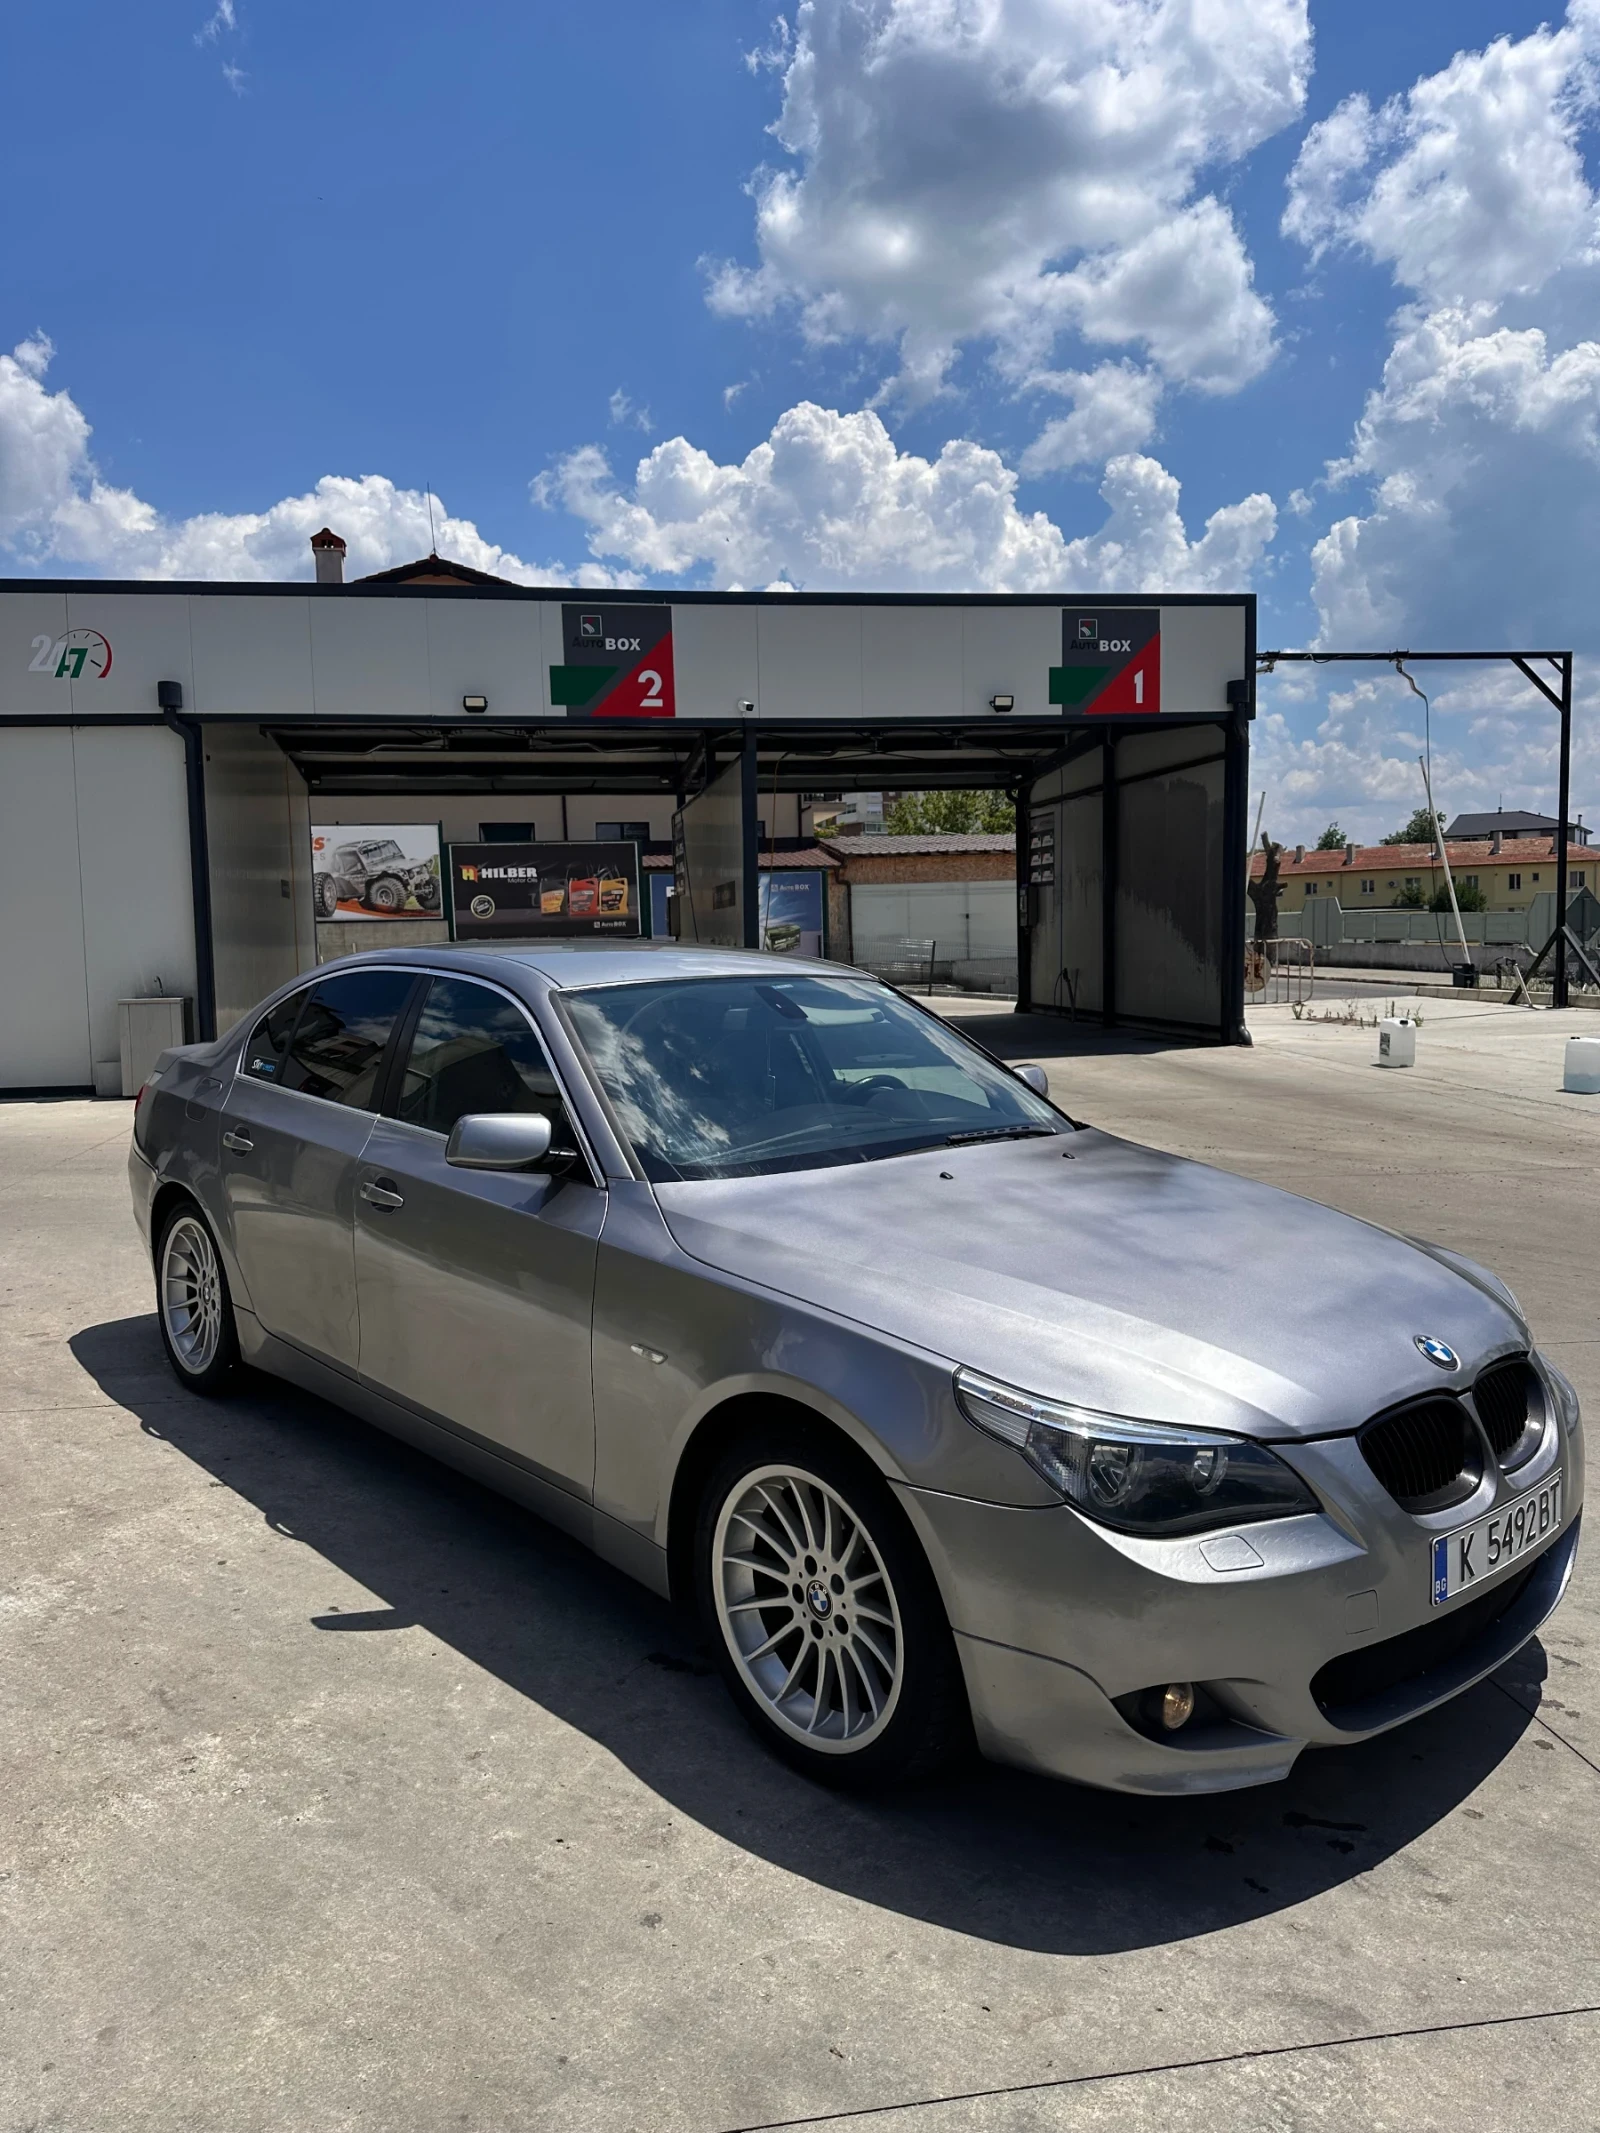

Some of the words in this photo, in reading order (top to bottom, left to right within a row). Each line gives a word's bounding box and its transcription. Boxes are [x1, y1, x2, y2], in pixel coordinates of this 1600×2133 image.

[604, 637, 641, 651] BOX
[1099, 639, 1131, 652] BOX
[637, 669, 664, 707] 2
[1134, 668, 1144, 704] 1
[481, 867, 538, 879] HILBER
[1460, 1531, 1476, 1582] K
[1435, 1578, 1447, 1594] BG
